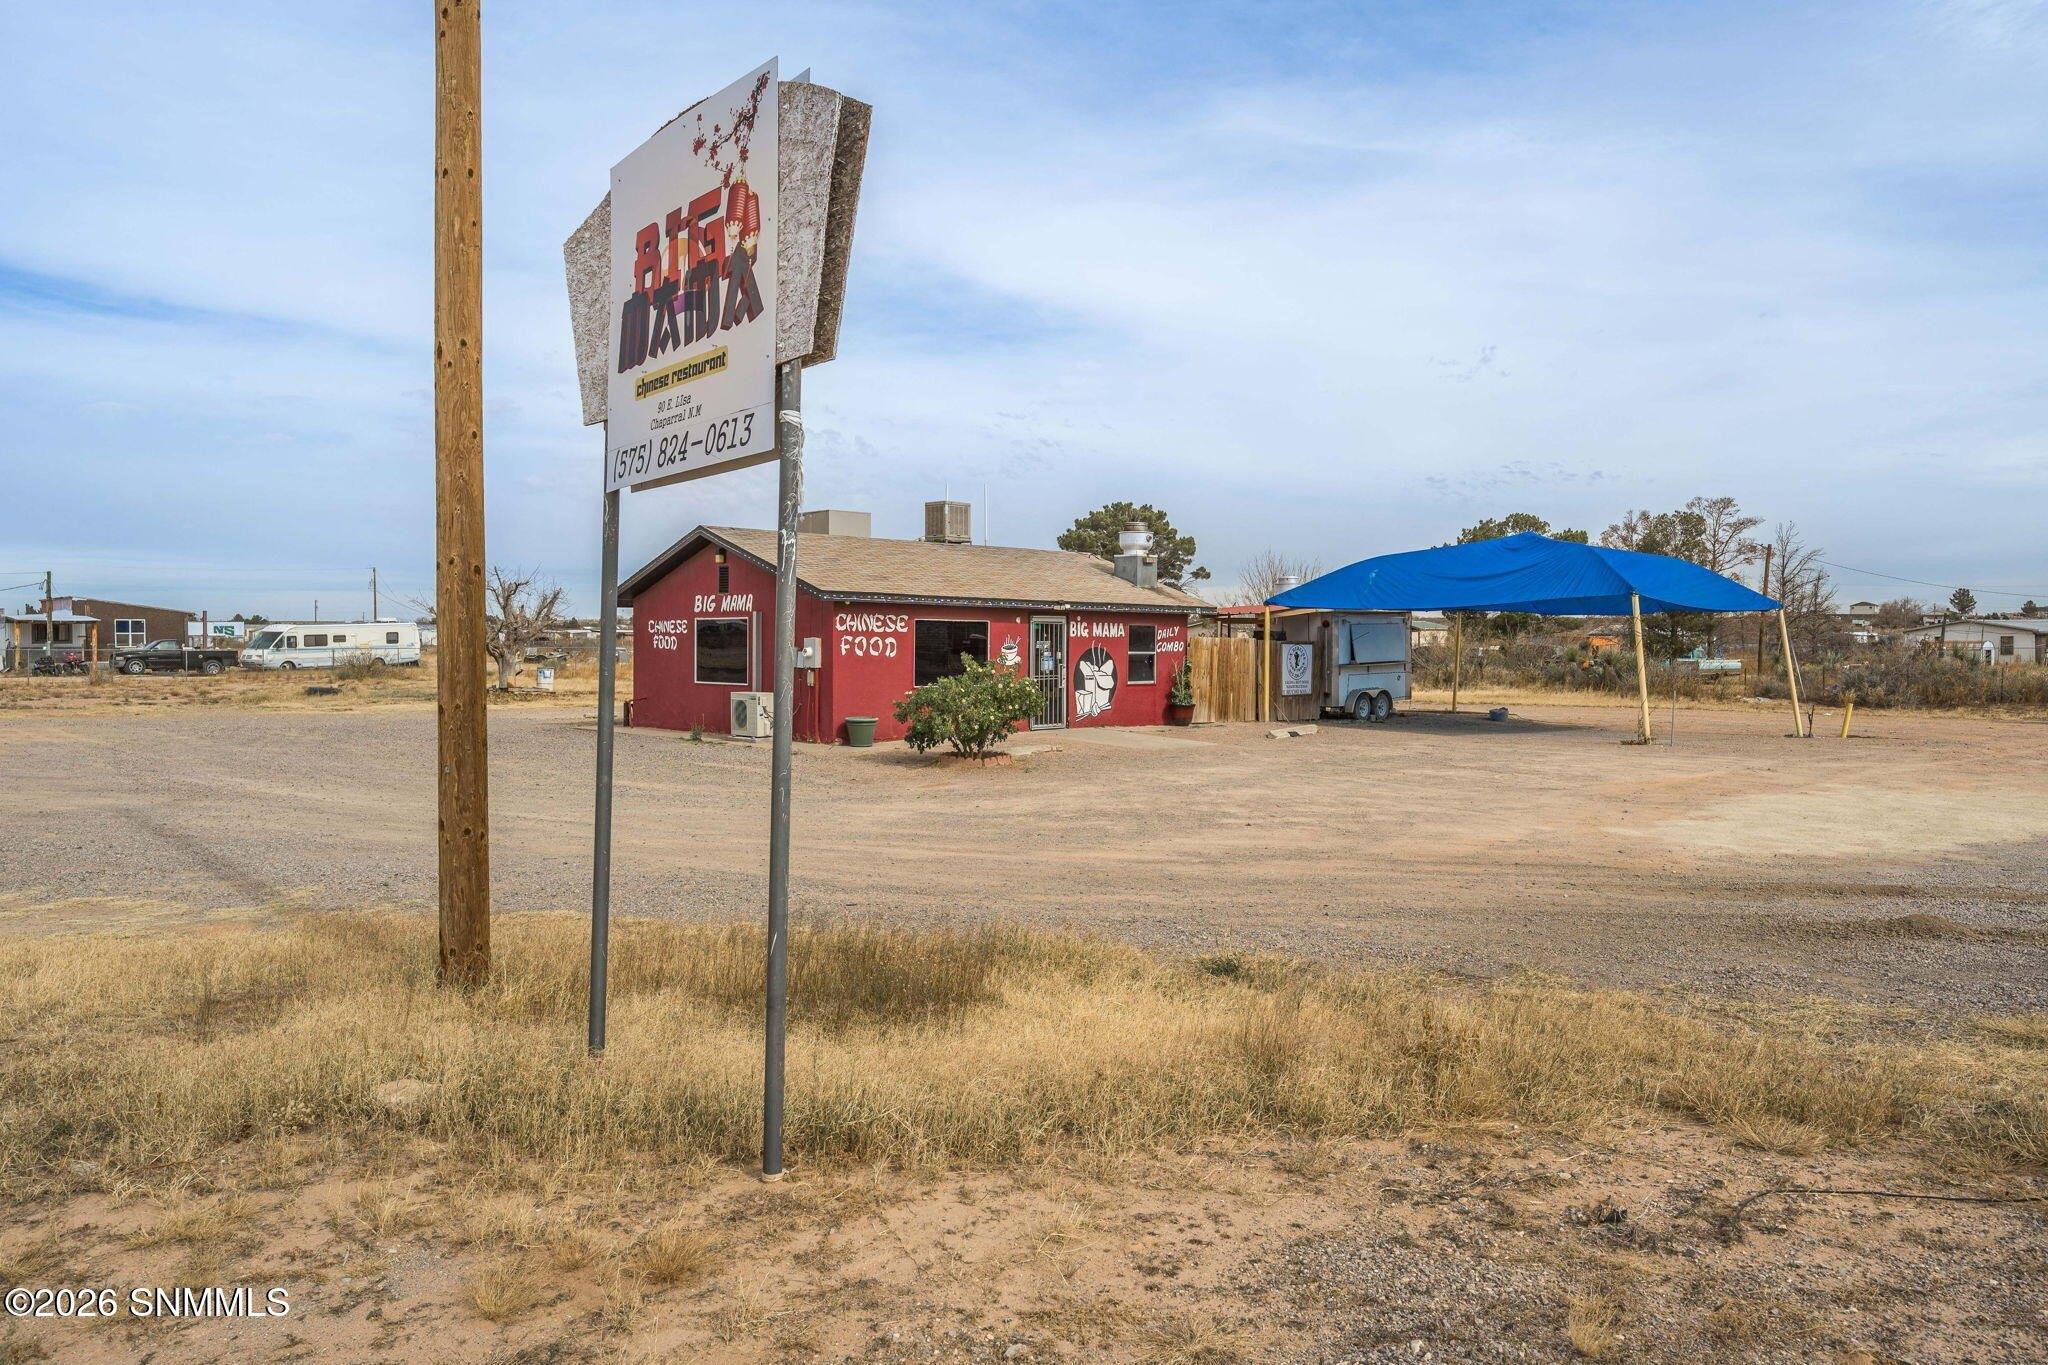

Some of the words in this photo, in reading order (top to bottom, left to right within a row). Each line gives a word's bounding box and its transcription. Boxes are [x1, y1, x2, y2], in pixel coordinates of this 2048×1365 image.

[634, 186, 731, 302] BIG
[636, 373, 670, 398] chinese
[671, 351, 726, 384] restaurant
[657, 400, 666, 414] 90
[650, 408, 686, 431] Chaparral
[613, 439, 653, 483] (575)
[657, 412, 755, 469] 824-0613
[694, 595, 716, 612] BIG
[721, 594, 753, 612] MAMA
[648, 620, 688, 634] CHINESE
[835, 613, 909, 633] CHINESE
[1093, 622, 1125, 637] MAMA
[1157, 626, 1180, 640] DAILY
[653, 635, 678, 651] FOOD
[839, 635, 897, 658] FOOD
[1156, 641, 1184, 653] COMBO
